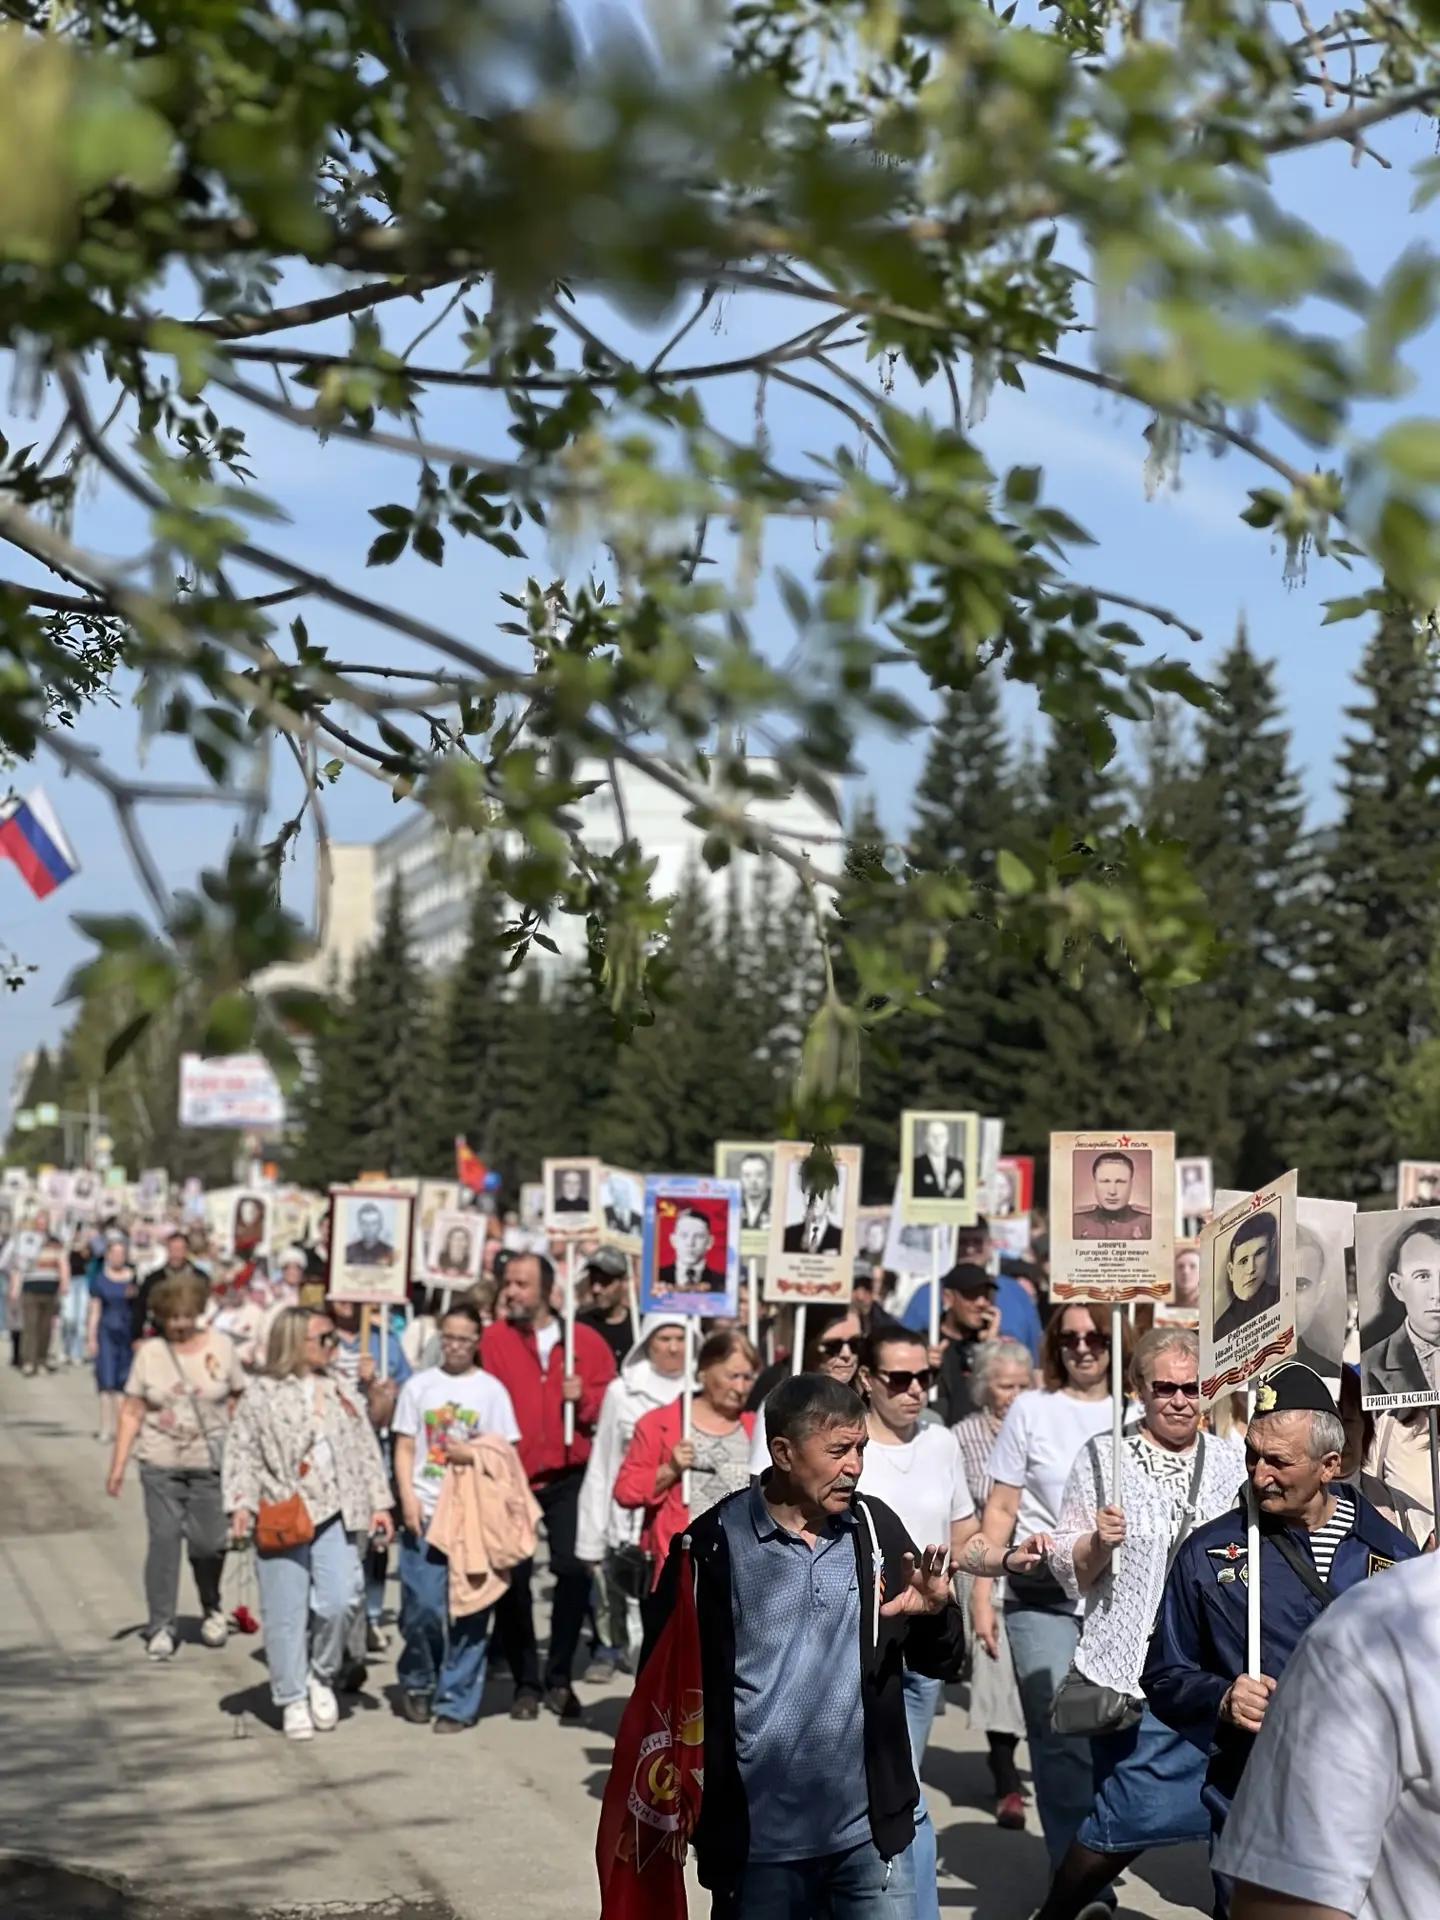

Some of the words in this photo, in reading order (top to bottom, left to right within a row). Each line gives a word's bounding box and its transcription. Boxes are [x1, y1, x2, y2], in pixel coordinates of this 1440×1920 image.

[1215, 1344, 1233, 1360] Иван
[1236, 1314, 1280, 1347] Степанович
[1227, 1313, 1267, 1343] Рябченков
[1366, 1395, 1398, 1407] ГРИПИЧ
[1401, 1390, 1440, 1404] ВАСИЛИЙ
